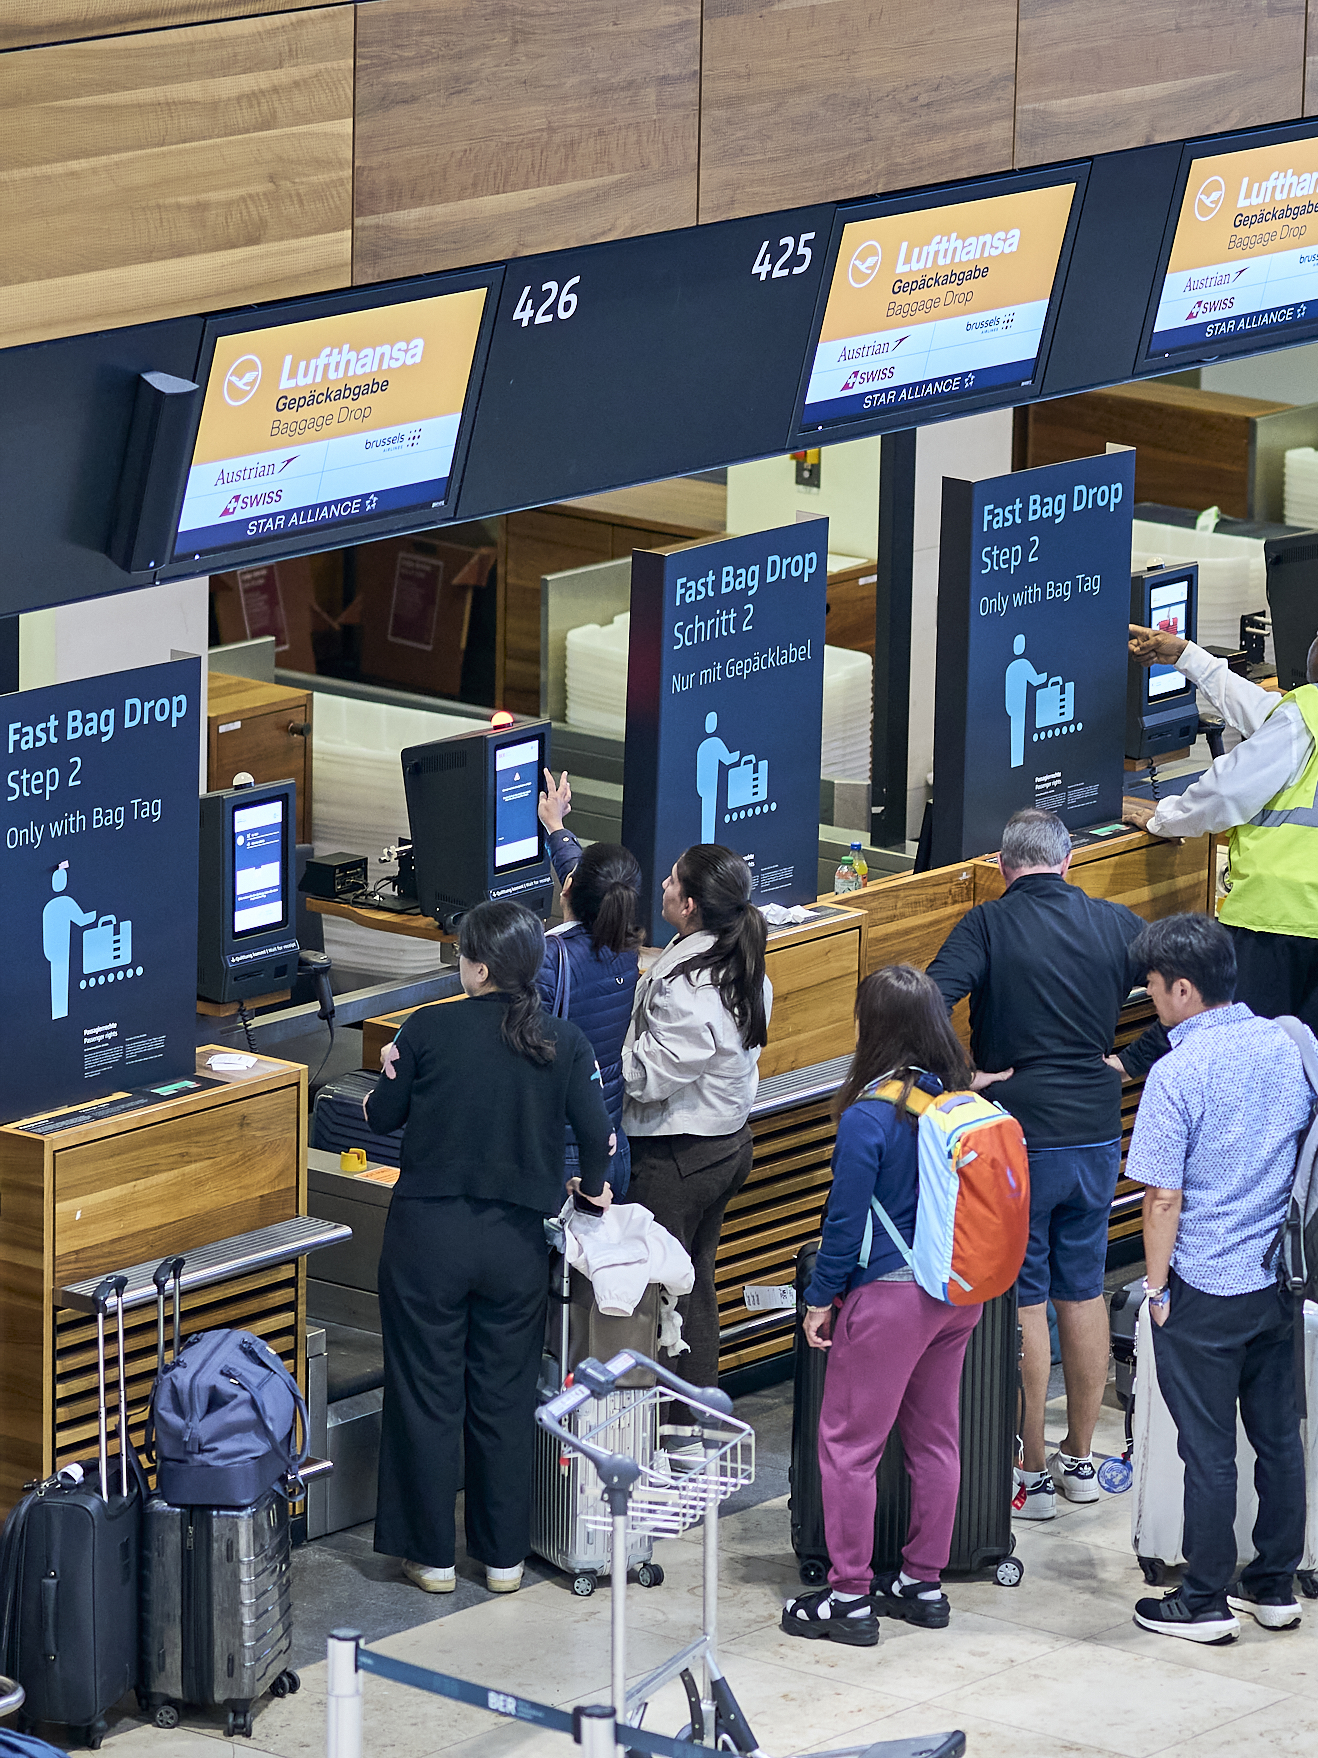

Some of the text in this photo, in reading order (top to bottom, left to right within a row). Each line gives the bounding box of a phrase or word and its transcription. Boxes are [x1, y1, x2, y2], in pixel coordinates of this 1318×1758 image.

[896, 227, 1021, 274] Lufthansa
[1228, 222, 1307, 251] Baggage Drop
[751, 232, 816, 281] 425
[891, 264, 989, 295] Gepäckabgabe
[1183, 271, 1230, 293] Austrian
[512, 276, 581, 328] 426
[885, 288, 974, 318] Baggage Drop
[1201, 296, 1235, 314] SWISS
[966, 316, 1000, 331] brussels
[1205, 307, 1294, 338] STAR ALLIANCE
[279, 337, 425, 389] Lufthansa
[837, 340, 890, 363] Austrian
[858, 366, 895, 384] SWISS
[276, 378, 389, 412] Gepäckabgabe
[863, 377, 961, 409] STAR ALLIANCE
[270, 404, 372, 438] Baggage Drop
[365, 433, 404, 449] brussels
[214, 460, 276, 486] Austrian
[240, 489, 283, 510] SWISS
[982, 479, 1123, 532] Fast Bag Drop
[247, 499, 362, 535] STAR ALLIANCE
[981, 536, 1039, 575] Step 2
[676, 551, 817, 606] Fast Bag Drop
[979, 572, 1101, 618] Only with Bag Tag
[673, 604, 754, 651] Schritt 2
[671, 640, 812, 694] Nur mit Gepäcklabel
[8, 692, 187, 754] Fast Bag Drop
[8, 757, 81, 802] Step 2
[7, 798, 161, 850] Only with Bag Tag
[488, 1690, 516, 1715] BER
